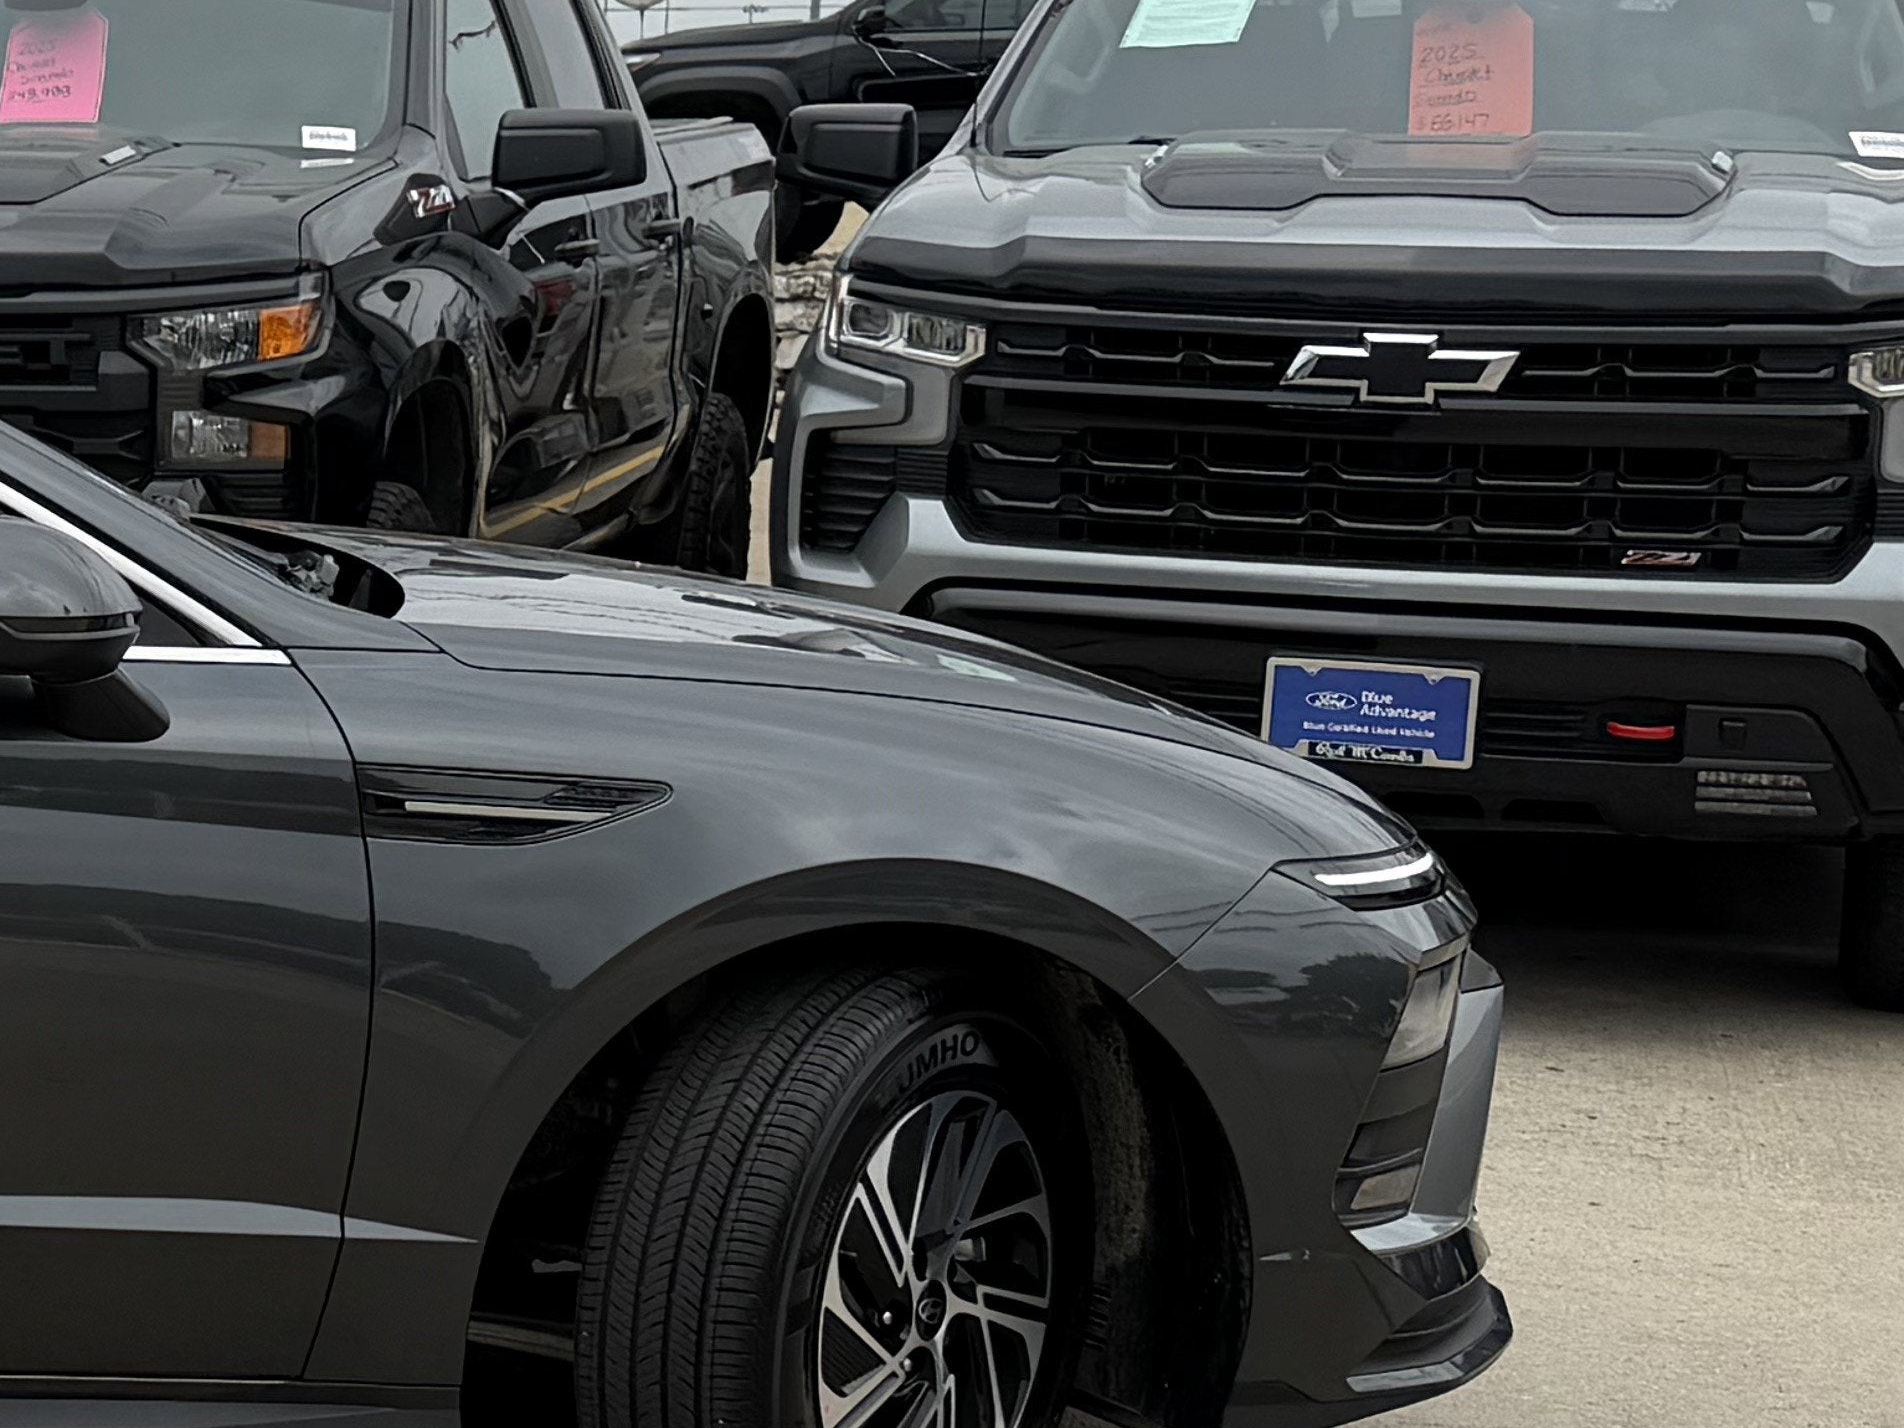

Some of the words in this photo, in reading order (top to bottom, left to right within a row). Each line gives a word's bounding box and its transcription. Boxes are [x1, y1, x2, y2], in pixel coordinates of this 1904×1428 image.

[1361, 690, 1394, 705] Blue
[1360, 703, 1437, 722] Advantage
[892, 1030, 980, 1097] UMHO
